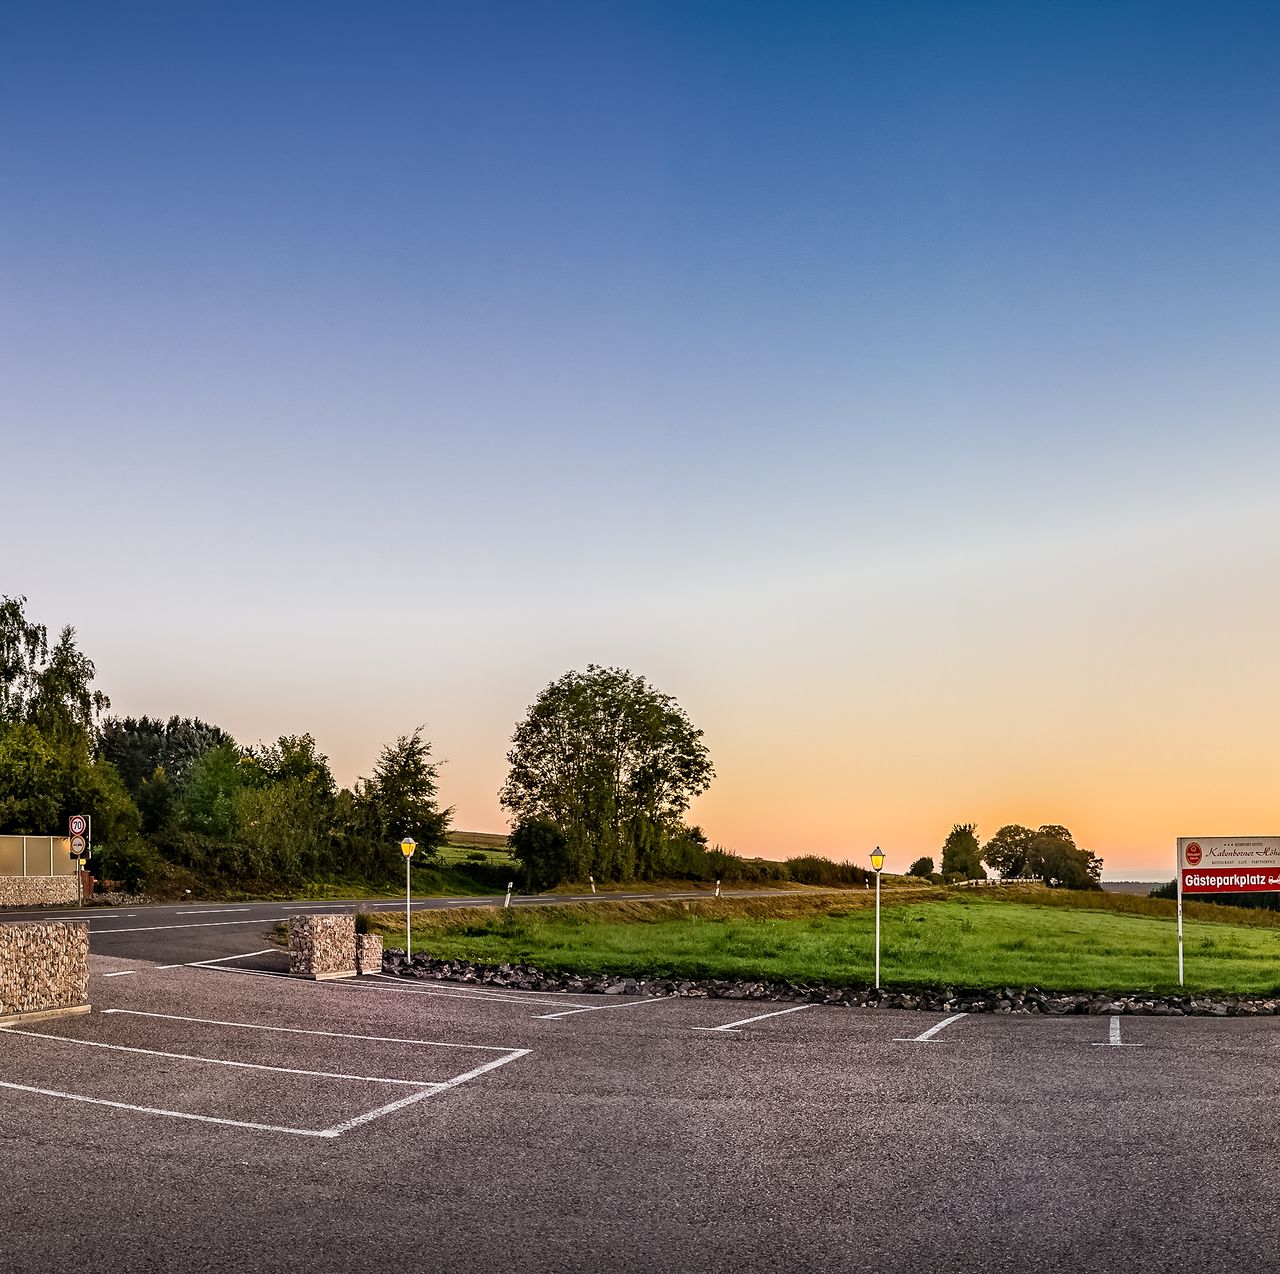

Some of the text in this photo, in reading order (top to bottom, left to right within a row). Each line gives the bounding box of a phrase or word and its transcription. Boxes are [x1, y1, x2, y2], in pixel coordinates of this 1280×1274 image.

[74, 821, 81, 829] 70
[1255, 846, 1280, 857] Höhe
[1185, 874, 1266, 888] Gästeparkplatz
